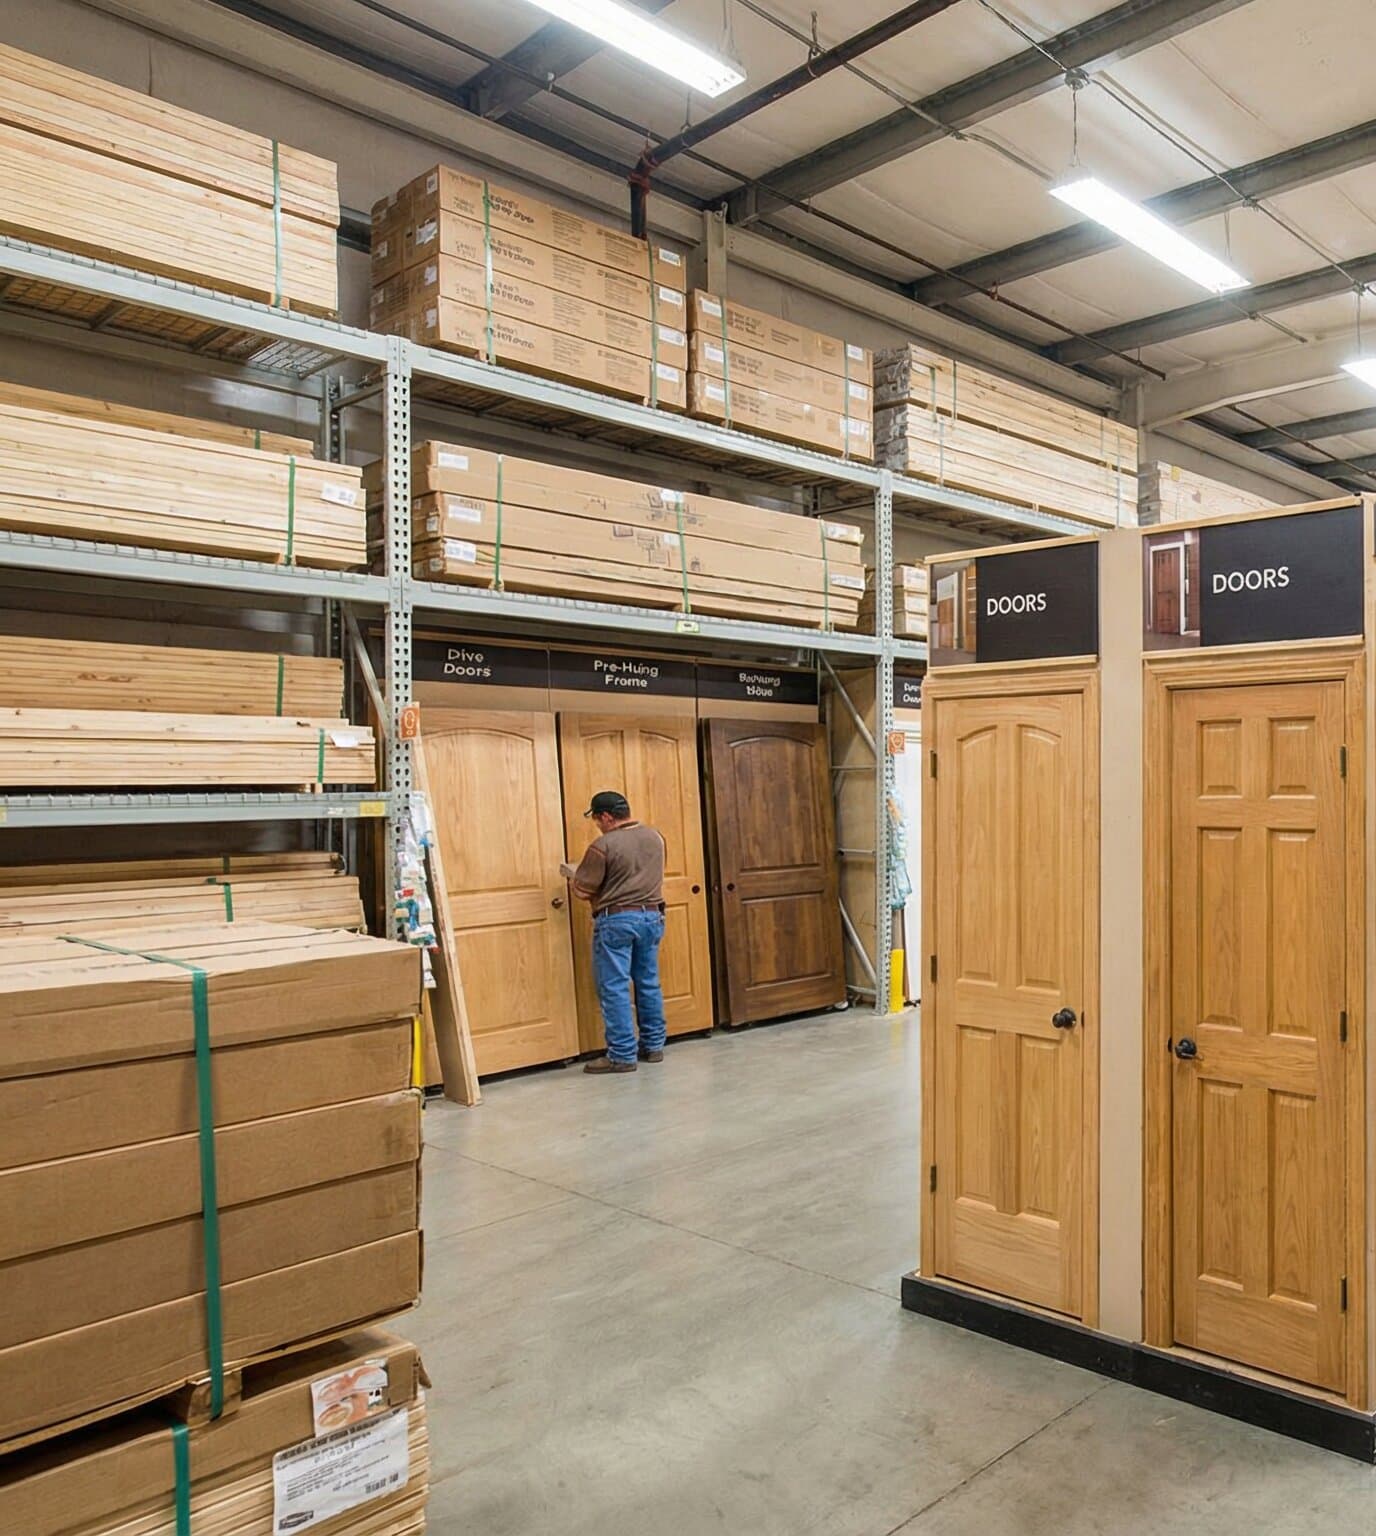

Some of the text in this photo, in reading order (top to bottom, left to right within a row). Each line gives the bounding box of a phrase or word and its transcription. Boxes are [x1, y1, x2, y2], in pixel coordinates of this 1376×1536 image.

[1212, 566, 1290, 594] DOORS
[987, 593, 1047, 616] DOORS
[443, 662, 492, 677] Doors
